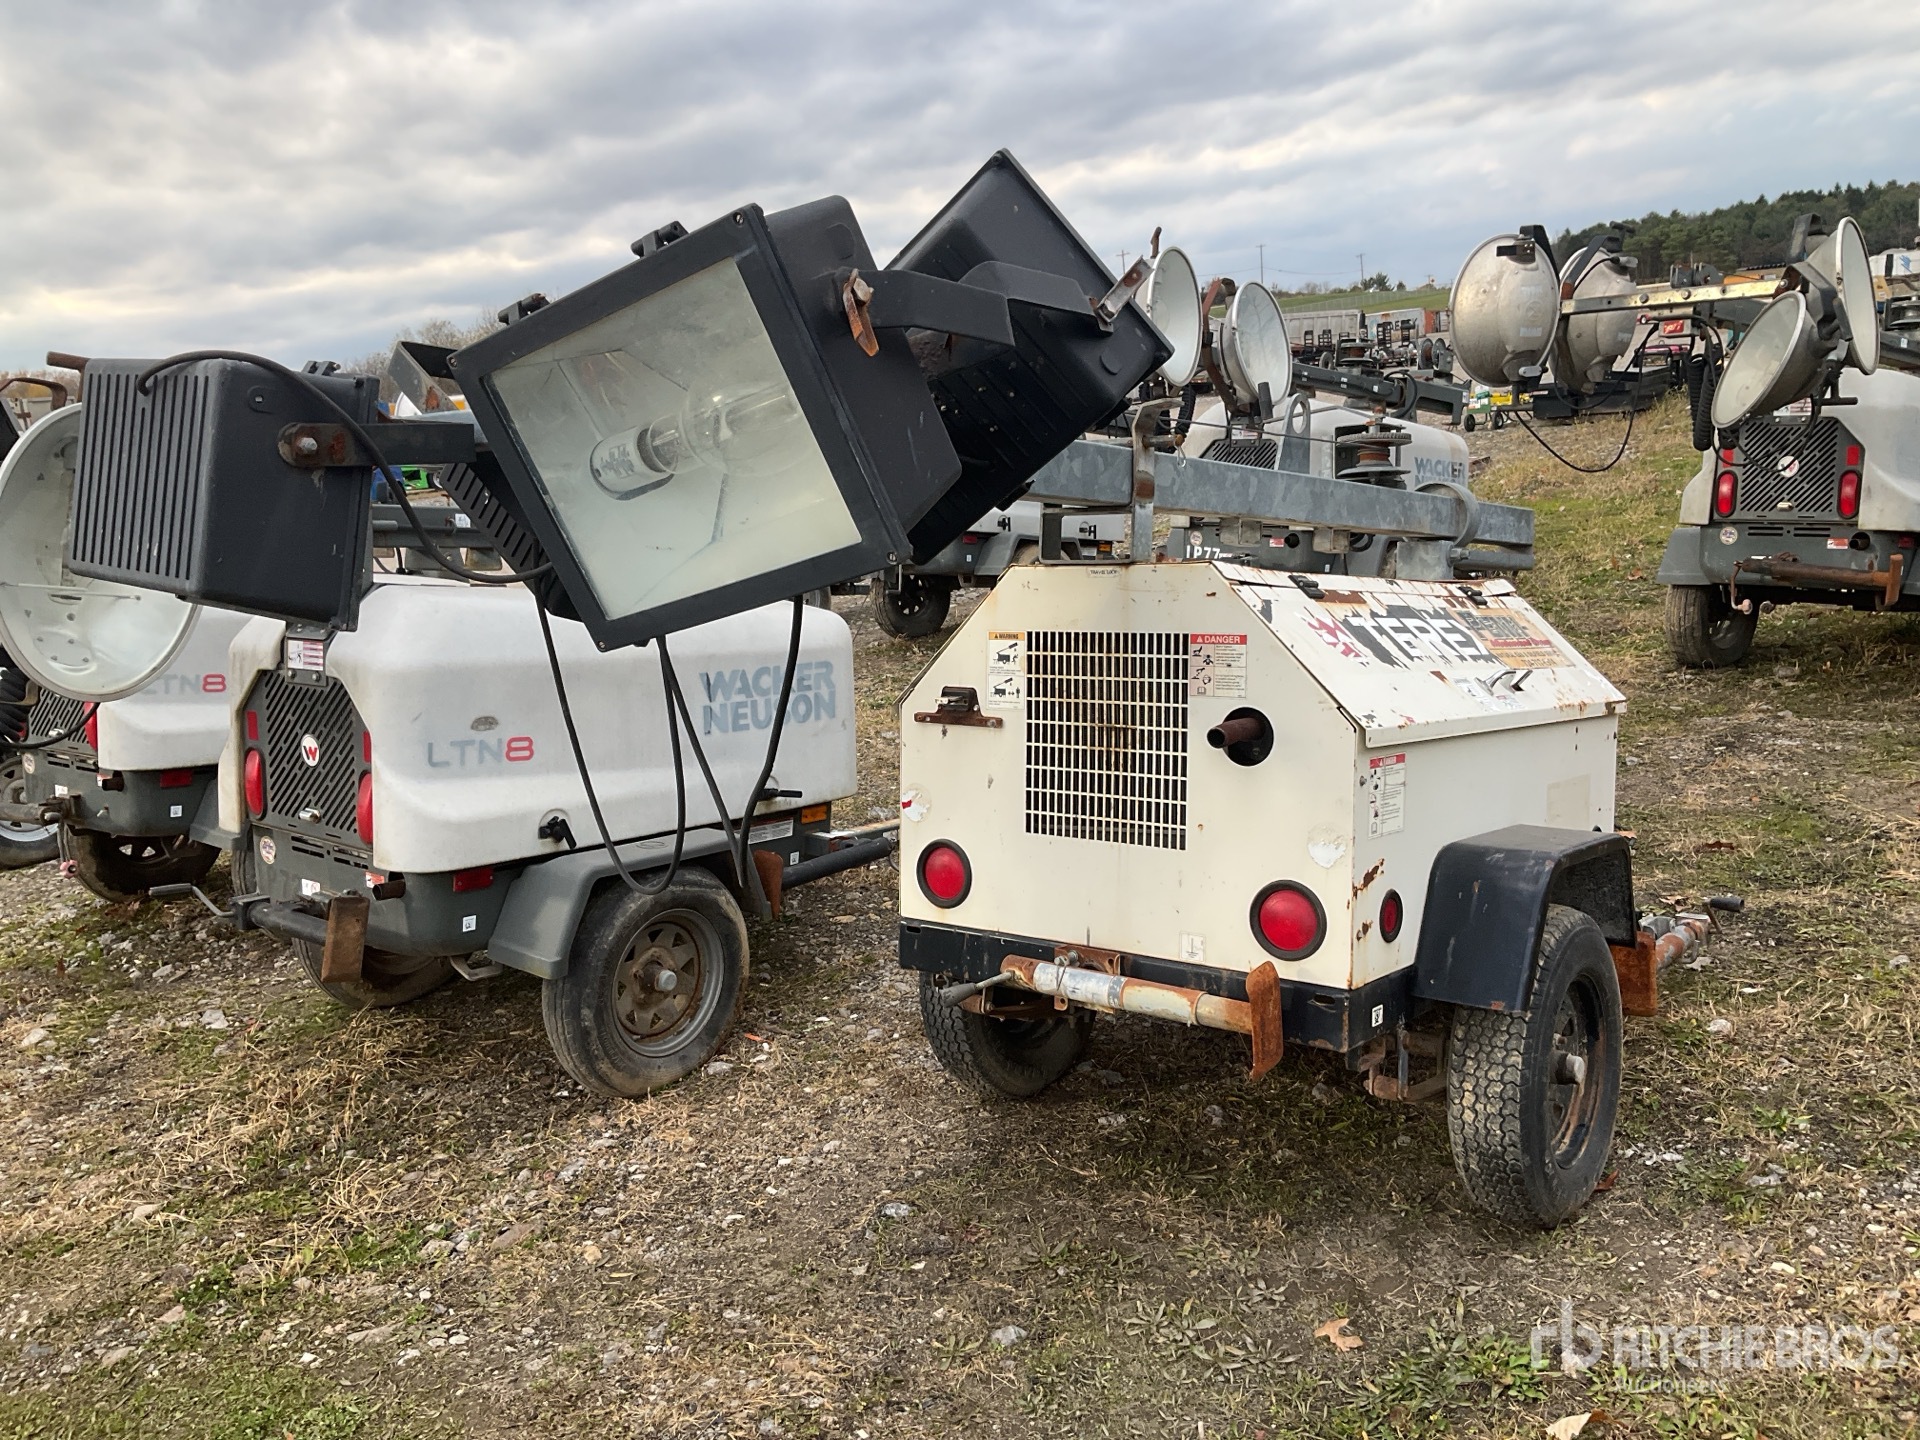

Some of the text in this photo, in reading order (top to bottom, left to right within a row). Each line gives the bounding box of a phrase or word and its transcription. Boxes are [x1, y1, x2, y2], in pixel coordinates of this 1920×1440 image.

[1414, 456, 1466, 478] WACKER
[1204, 635, 1241, 644] DANGER
[427, 736, 534, 768] LTN8
